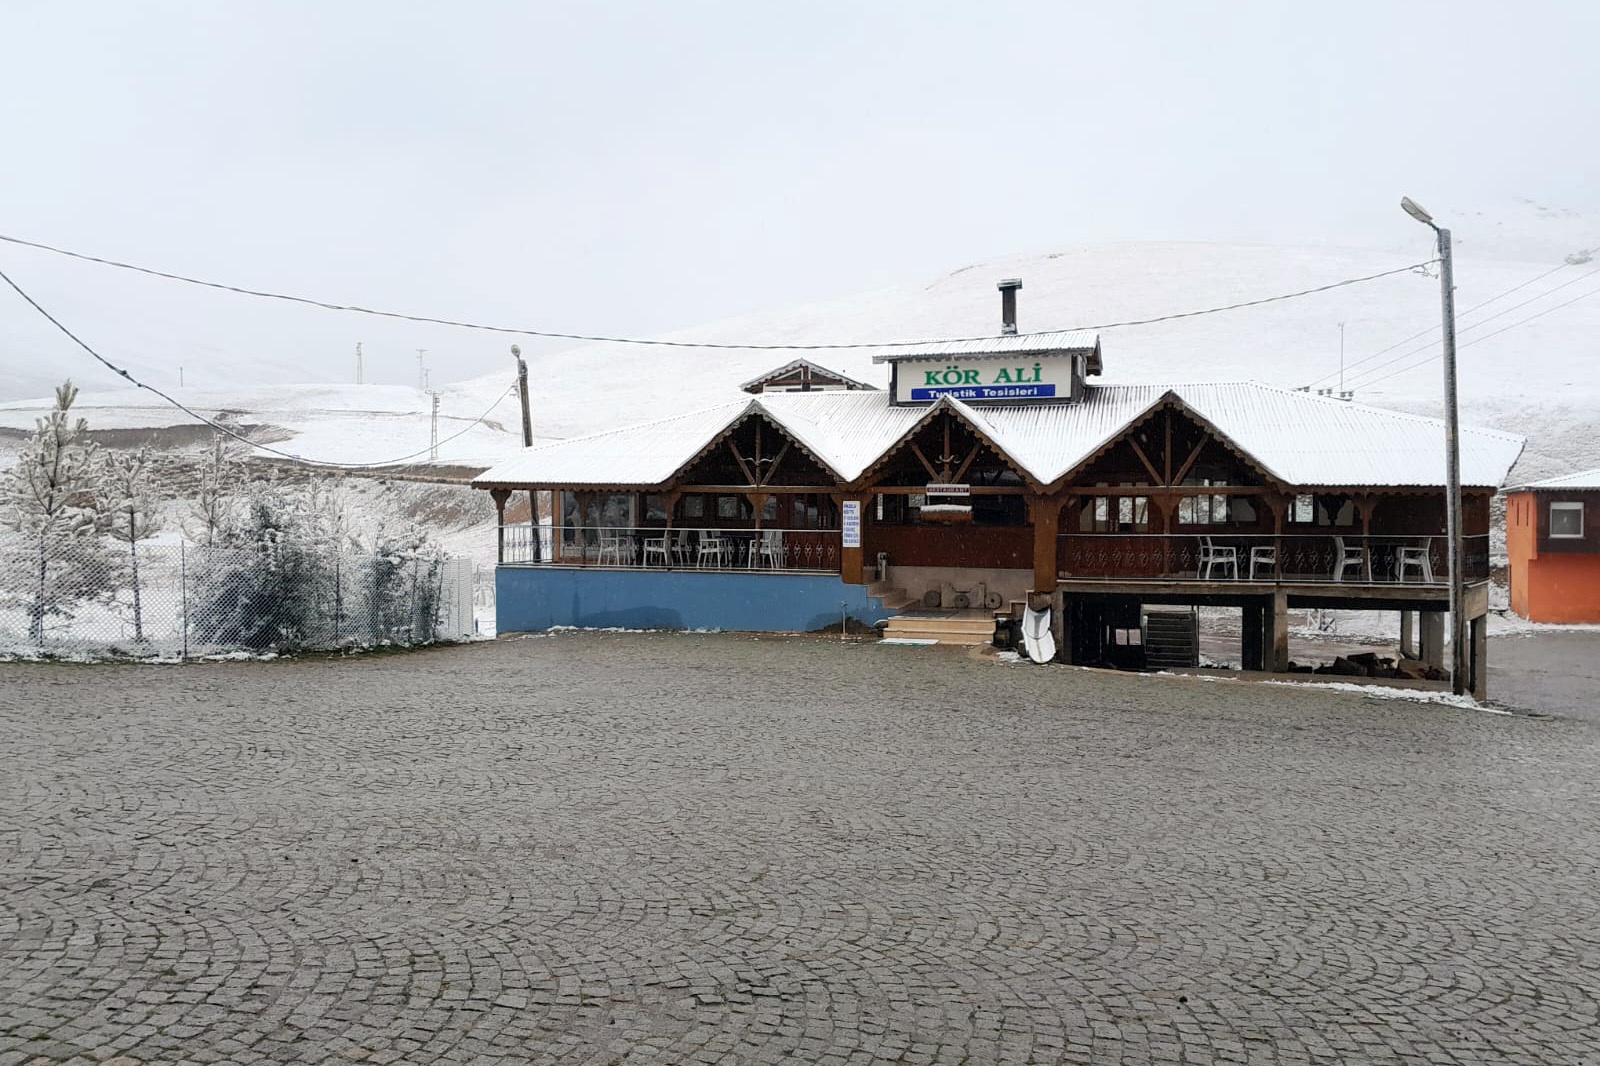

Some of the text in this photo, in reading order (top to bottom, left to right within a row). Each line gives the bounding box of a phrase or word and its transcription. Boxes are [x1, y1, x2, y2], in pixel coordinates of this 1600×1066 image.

[924, 363, 1042, 386] KÖR ALİ
[982, 387, 1038, 397] Tesisleri
